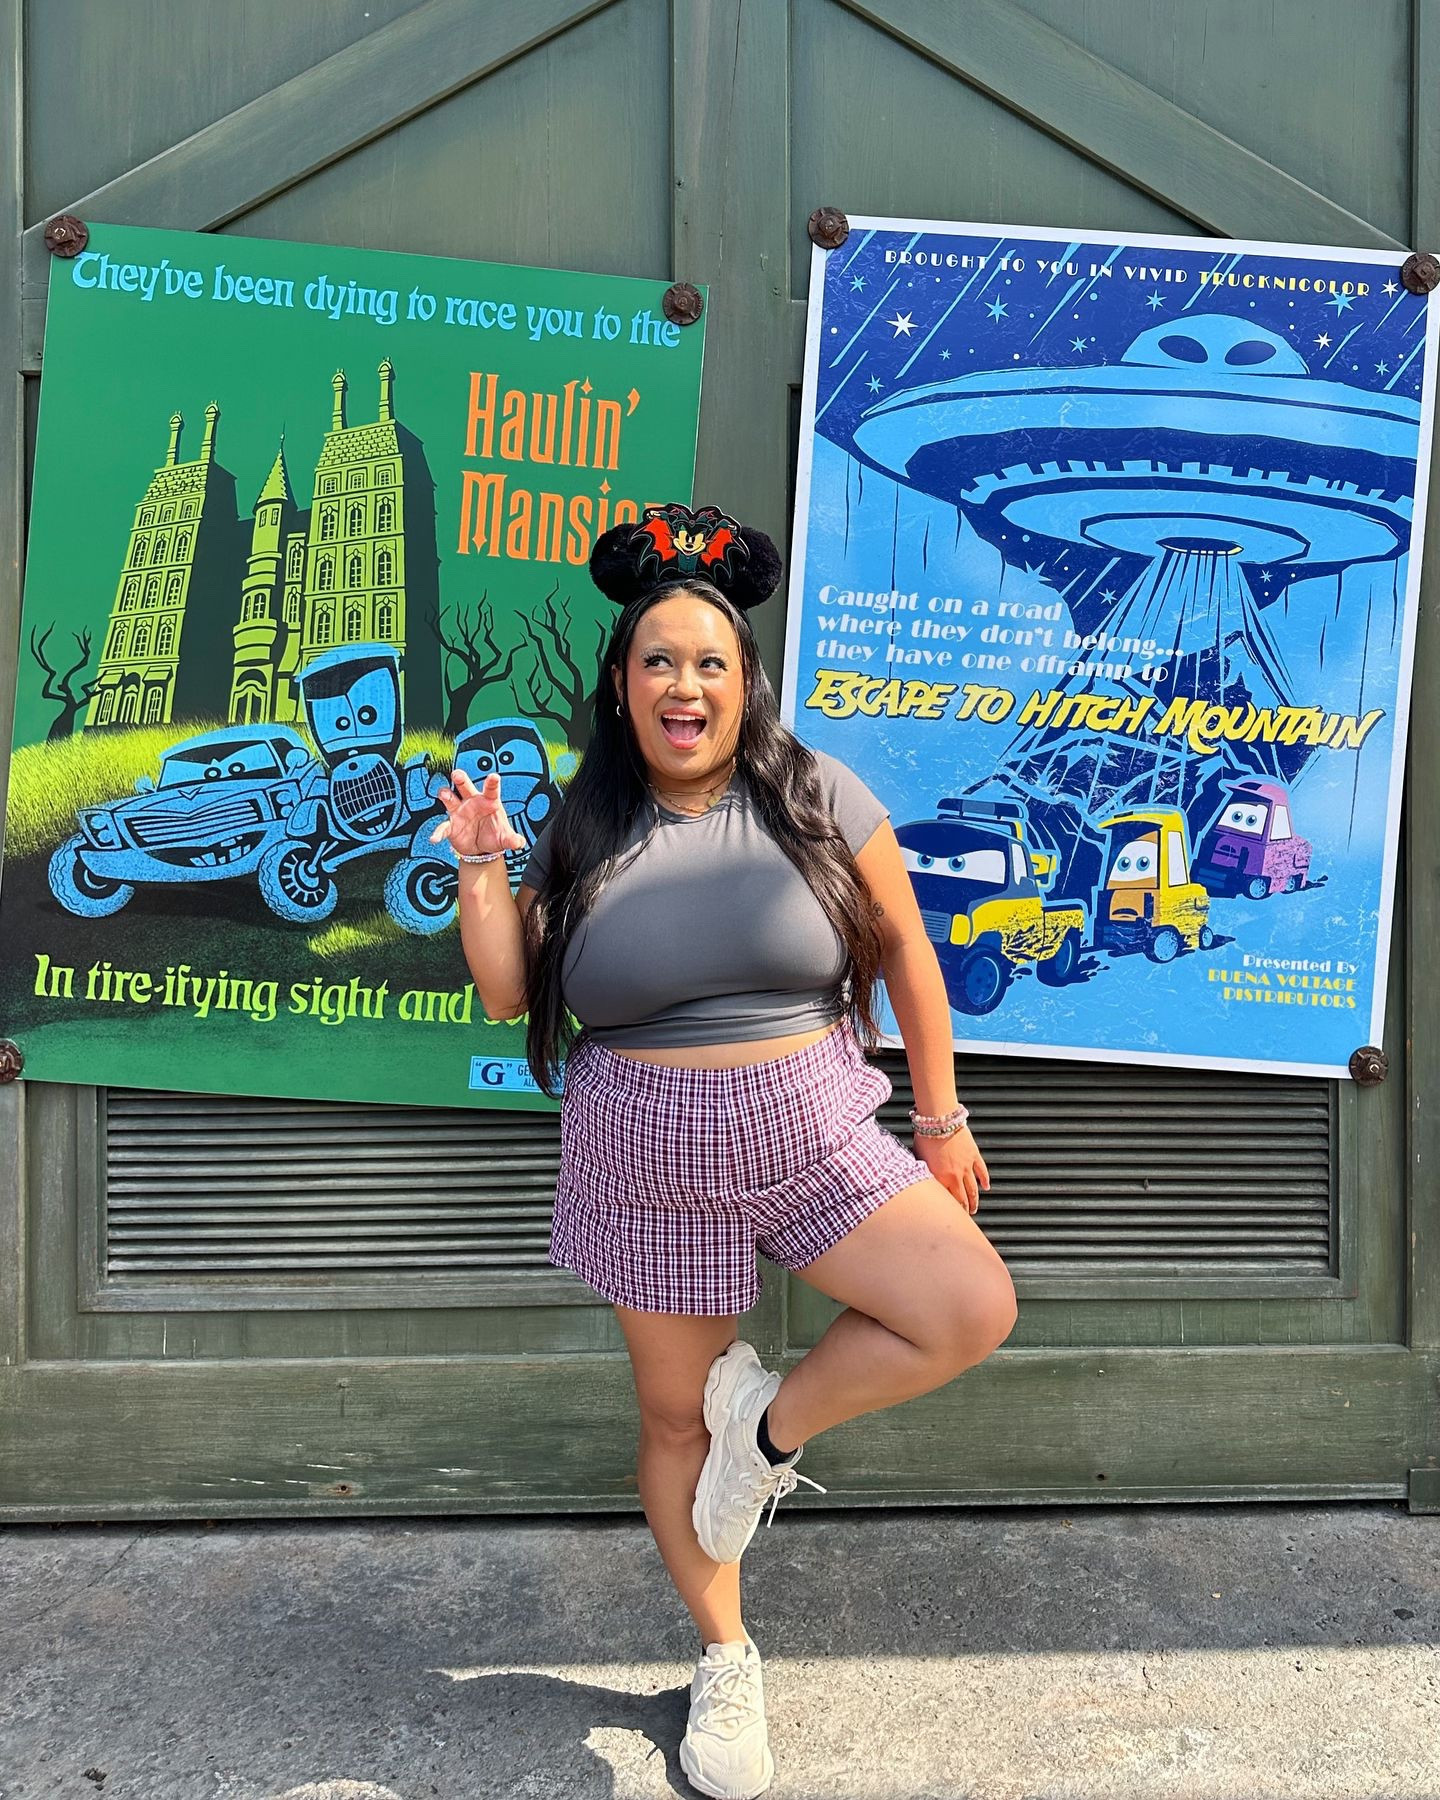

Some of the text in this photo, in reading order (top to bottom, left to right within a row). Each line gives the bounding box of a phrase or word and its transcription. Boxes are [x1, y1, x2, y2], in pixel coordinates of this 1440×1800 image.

[885, 250, 1370, 296] BROUGHT TO YOU IN VIVID TRUCKNICOLOR
[72, 251, 681, 347] They've been dying to race you to the
[456, 471, 670, 566] Mansi
[818, 585, 1062, 621] Caught on a road
[817, 614, 1184, 660] where they don't belong...
[816, 639, 1169, 682] they have one offramp to
[805, 669, 1385, 753] ESCAPE TO HITCH MOUNTAIN
[1208, 969, 1357, 991] BUENA VOLTAGE
[1242, 954, 1359, 975] Presented By
[34, 953, 75, 999] In
[85, 960, 279, 1022] tire-ifying
[288, 976, 389, 1025] sight
[398, 983, 475, 1023] and
[1223, 987, 1356, 1008] DISTRIBUTORS
